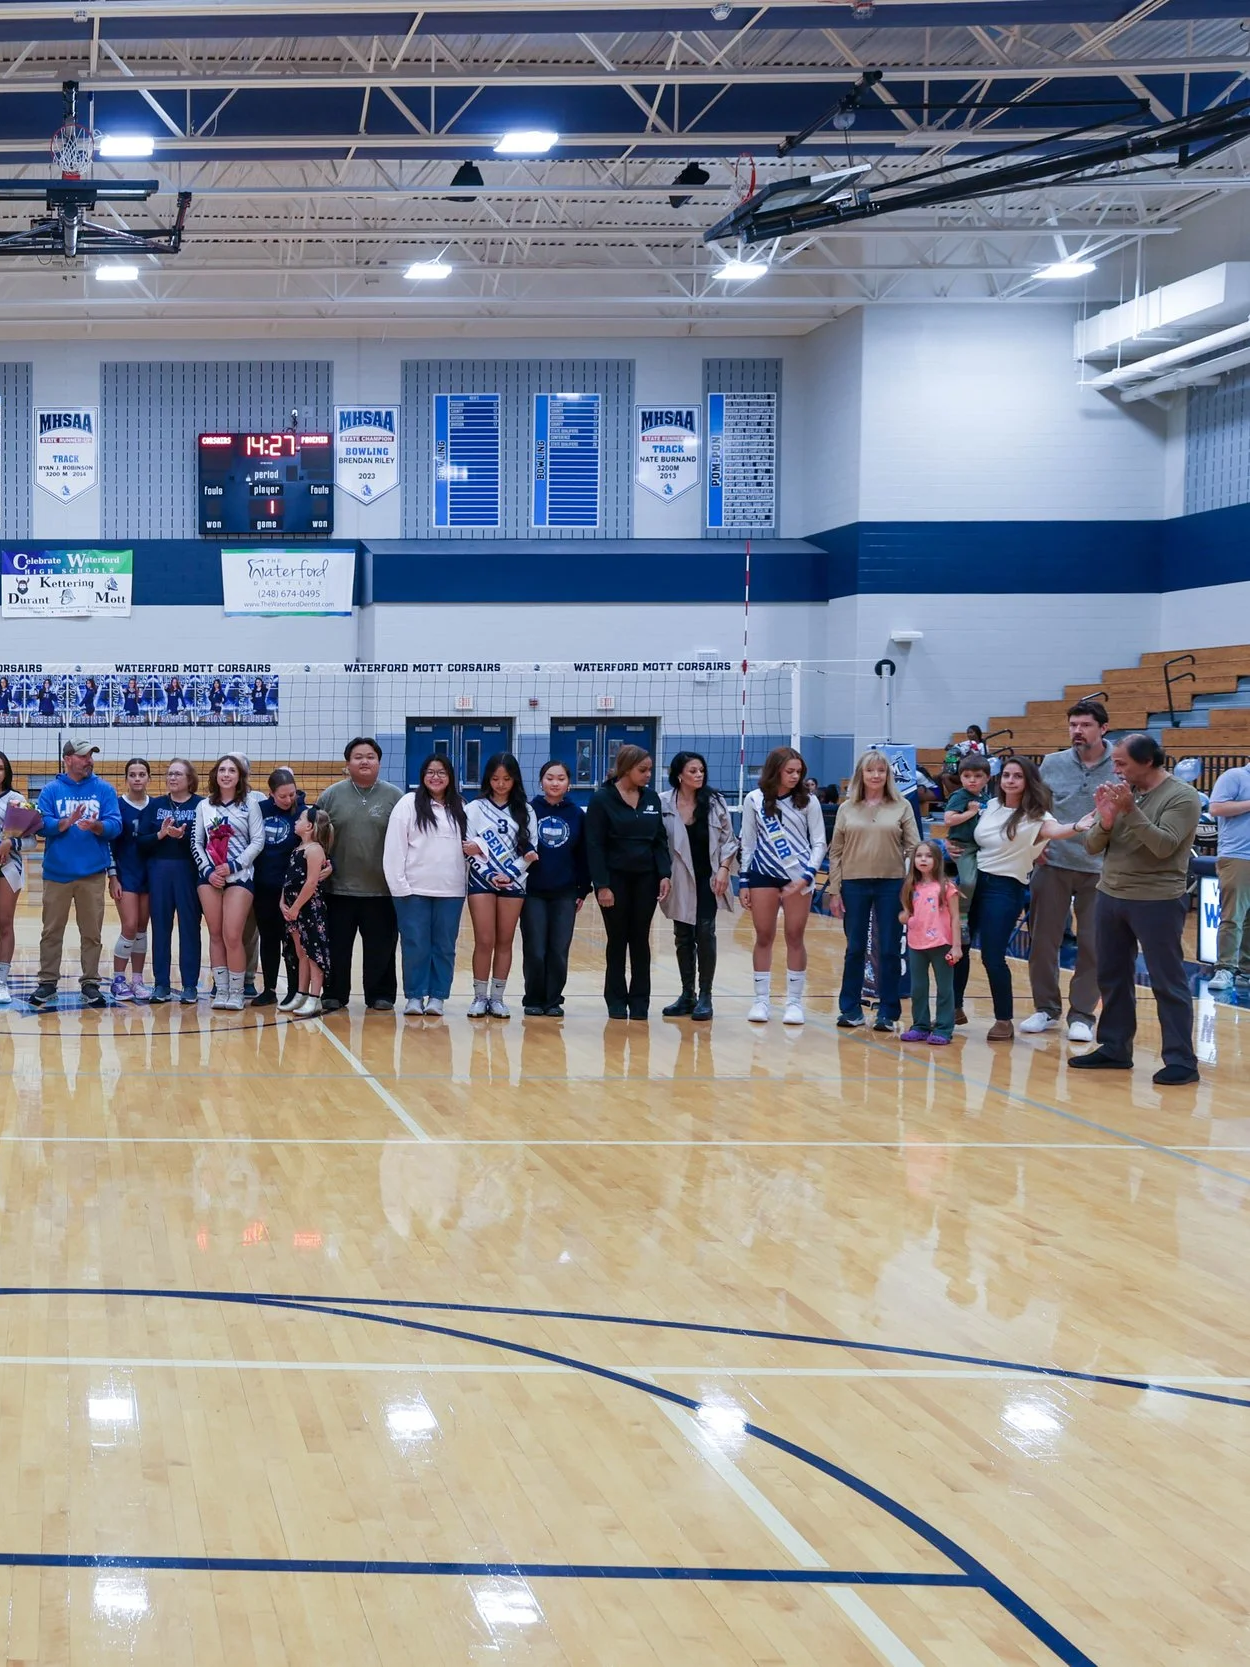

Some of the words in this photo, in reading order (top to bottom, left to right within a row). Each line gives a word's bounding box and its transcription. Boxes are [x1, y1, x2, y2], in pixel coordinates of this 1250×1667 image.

[39, 413, 93, 436] MHSAA
[339, 410, 395, 435] MHSAA
[641, 410, 695, 434] MHSAA
[246, 435, 295, 456] 14:27
[652, 445, 684, 453] TRACK
[345, 447, 389, 456] BOWLING
[52, 455, 79, 463] TRACK
[537, 441, 545, 480] BOWLING
[254, 470, 279, 480] period
[204, 486, 223, 495] fouls
[253, 485, 280, 496] player
[310, 485, 329, 494] fouls
[270, 500, 275, 514] 1
[206, 520, 222, 529] won
[256, 520, 277, 530] game
[312, 520, 328, 528] won
[13, 553, 61, 570] Celebrate
[67, 553, 120, 568] Waterford
[247, 559, 329, 579] Waterford
[40, 576, 94, 589] Kettering
[8, 593, 50, 604] Durant
[95, 592, 126, 603] Mott
[258, 589, 279, 598] (248)
[281, 589, 321, 598] 674-0495
[115, 664, 179, 673] WATERFORD
[183, 664, 214, 673] MOTT
[217, 664, 271, 673] CORSAIRS
[344, 663, 408, 672] WATERFORD
[412, 663, 443, 672] MOTT
[447, 663, 501, 672] CORSAIRS
[574, 663, 638, 672] WATERFORD
[642, 663, 673, 672] MOTT
[677, 662, 731, 671] CORSAIRS
[497, 818, 509, 834] 3
